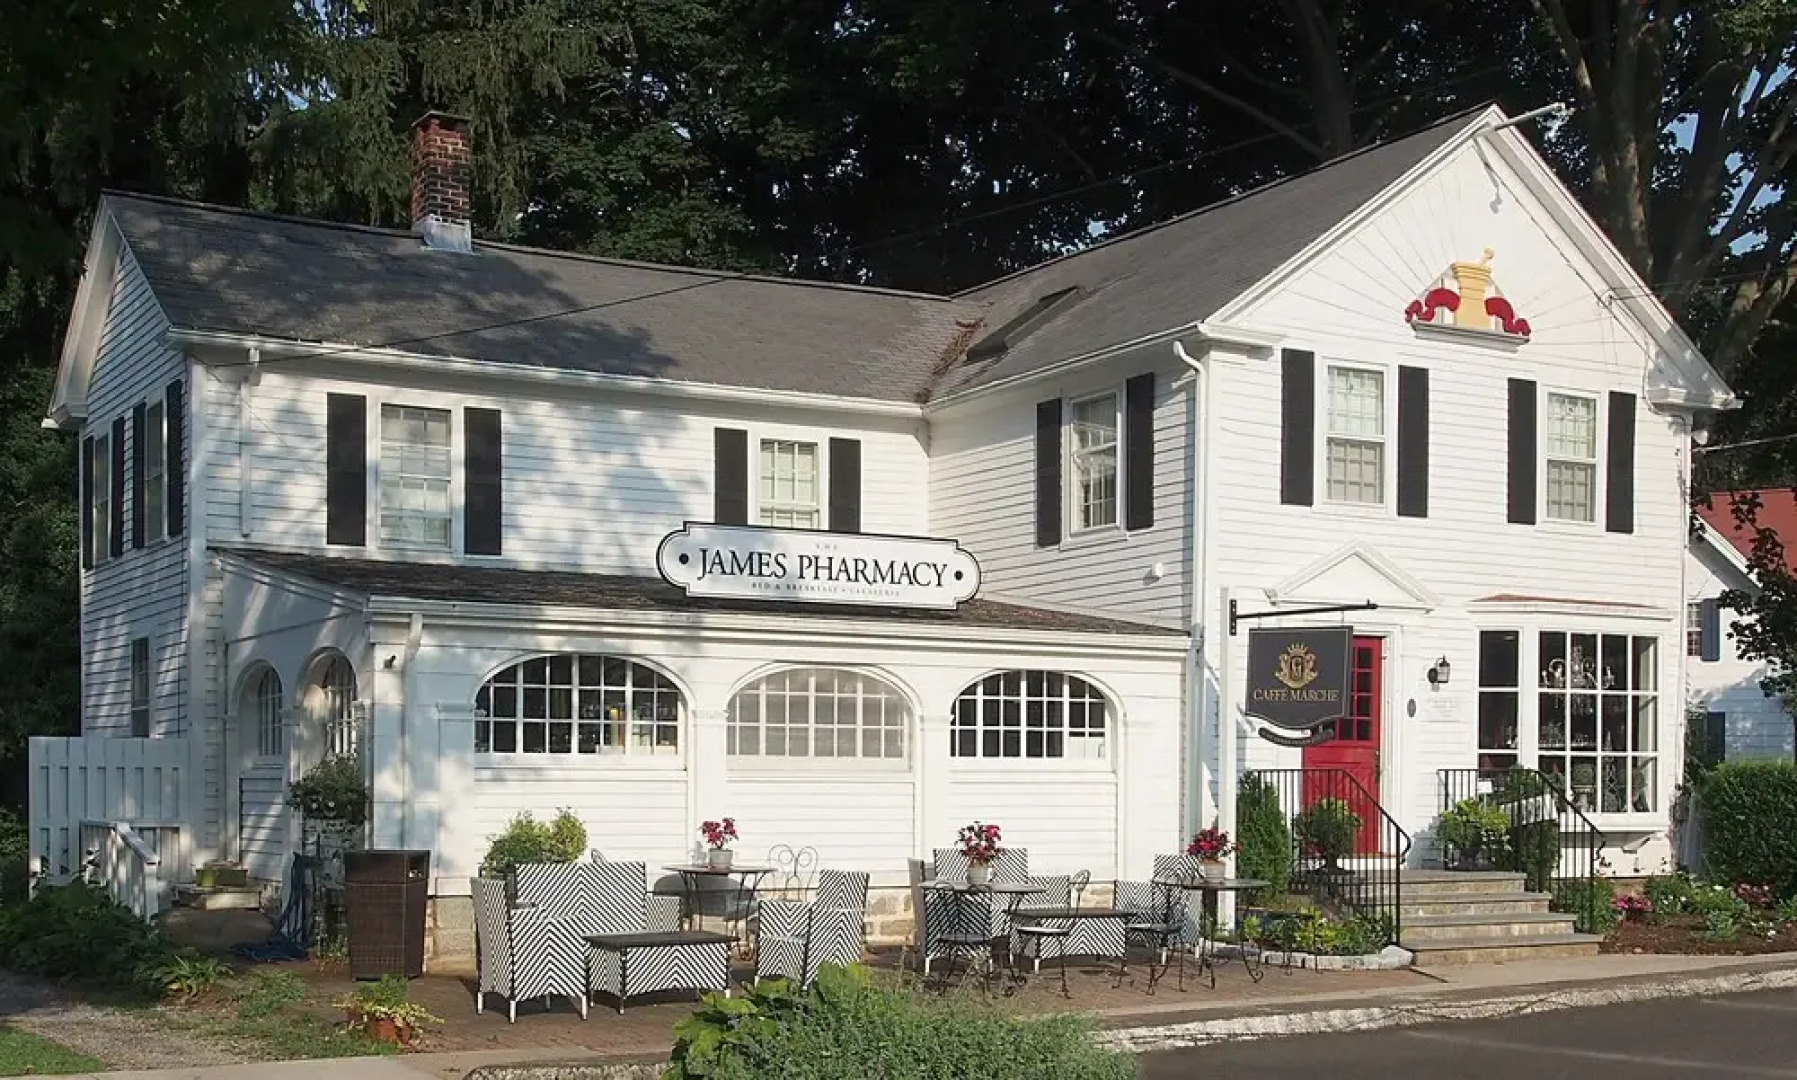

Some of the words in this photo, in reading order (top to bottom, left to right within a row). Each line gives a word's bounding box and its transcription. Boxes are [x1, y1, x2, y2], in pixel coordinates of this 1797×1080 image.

[697, 547, 787, 581] JAMES
[797, 554, 948, 587] PHARMACY
[1289, 689, 1340, 702] MARCHE
